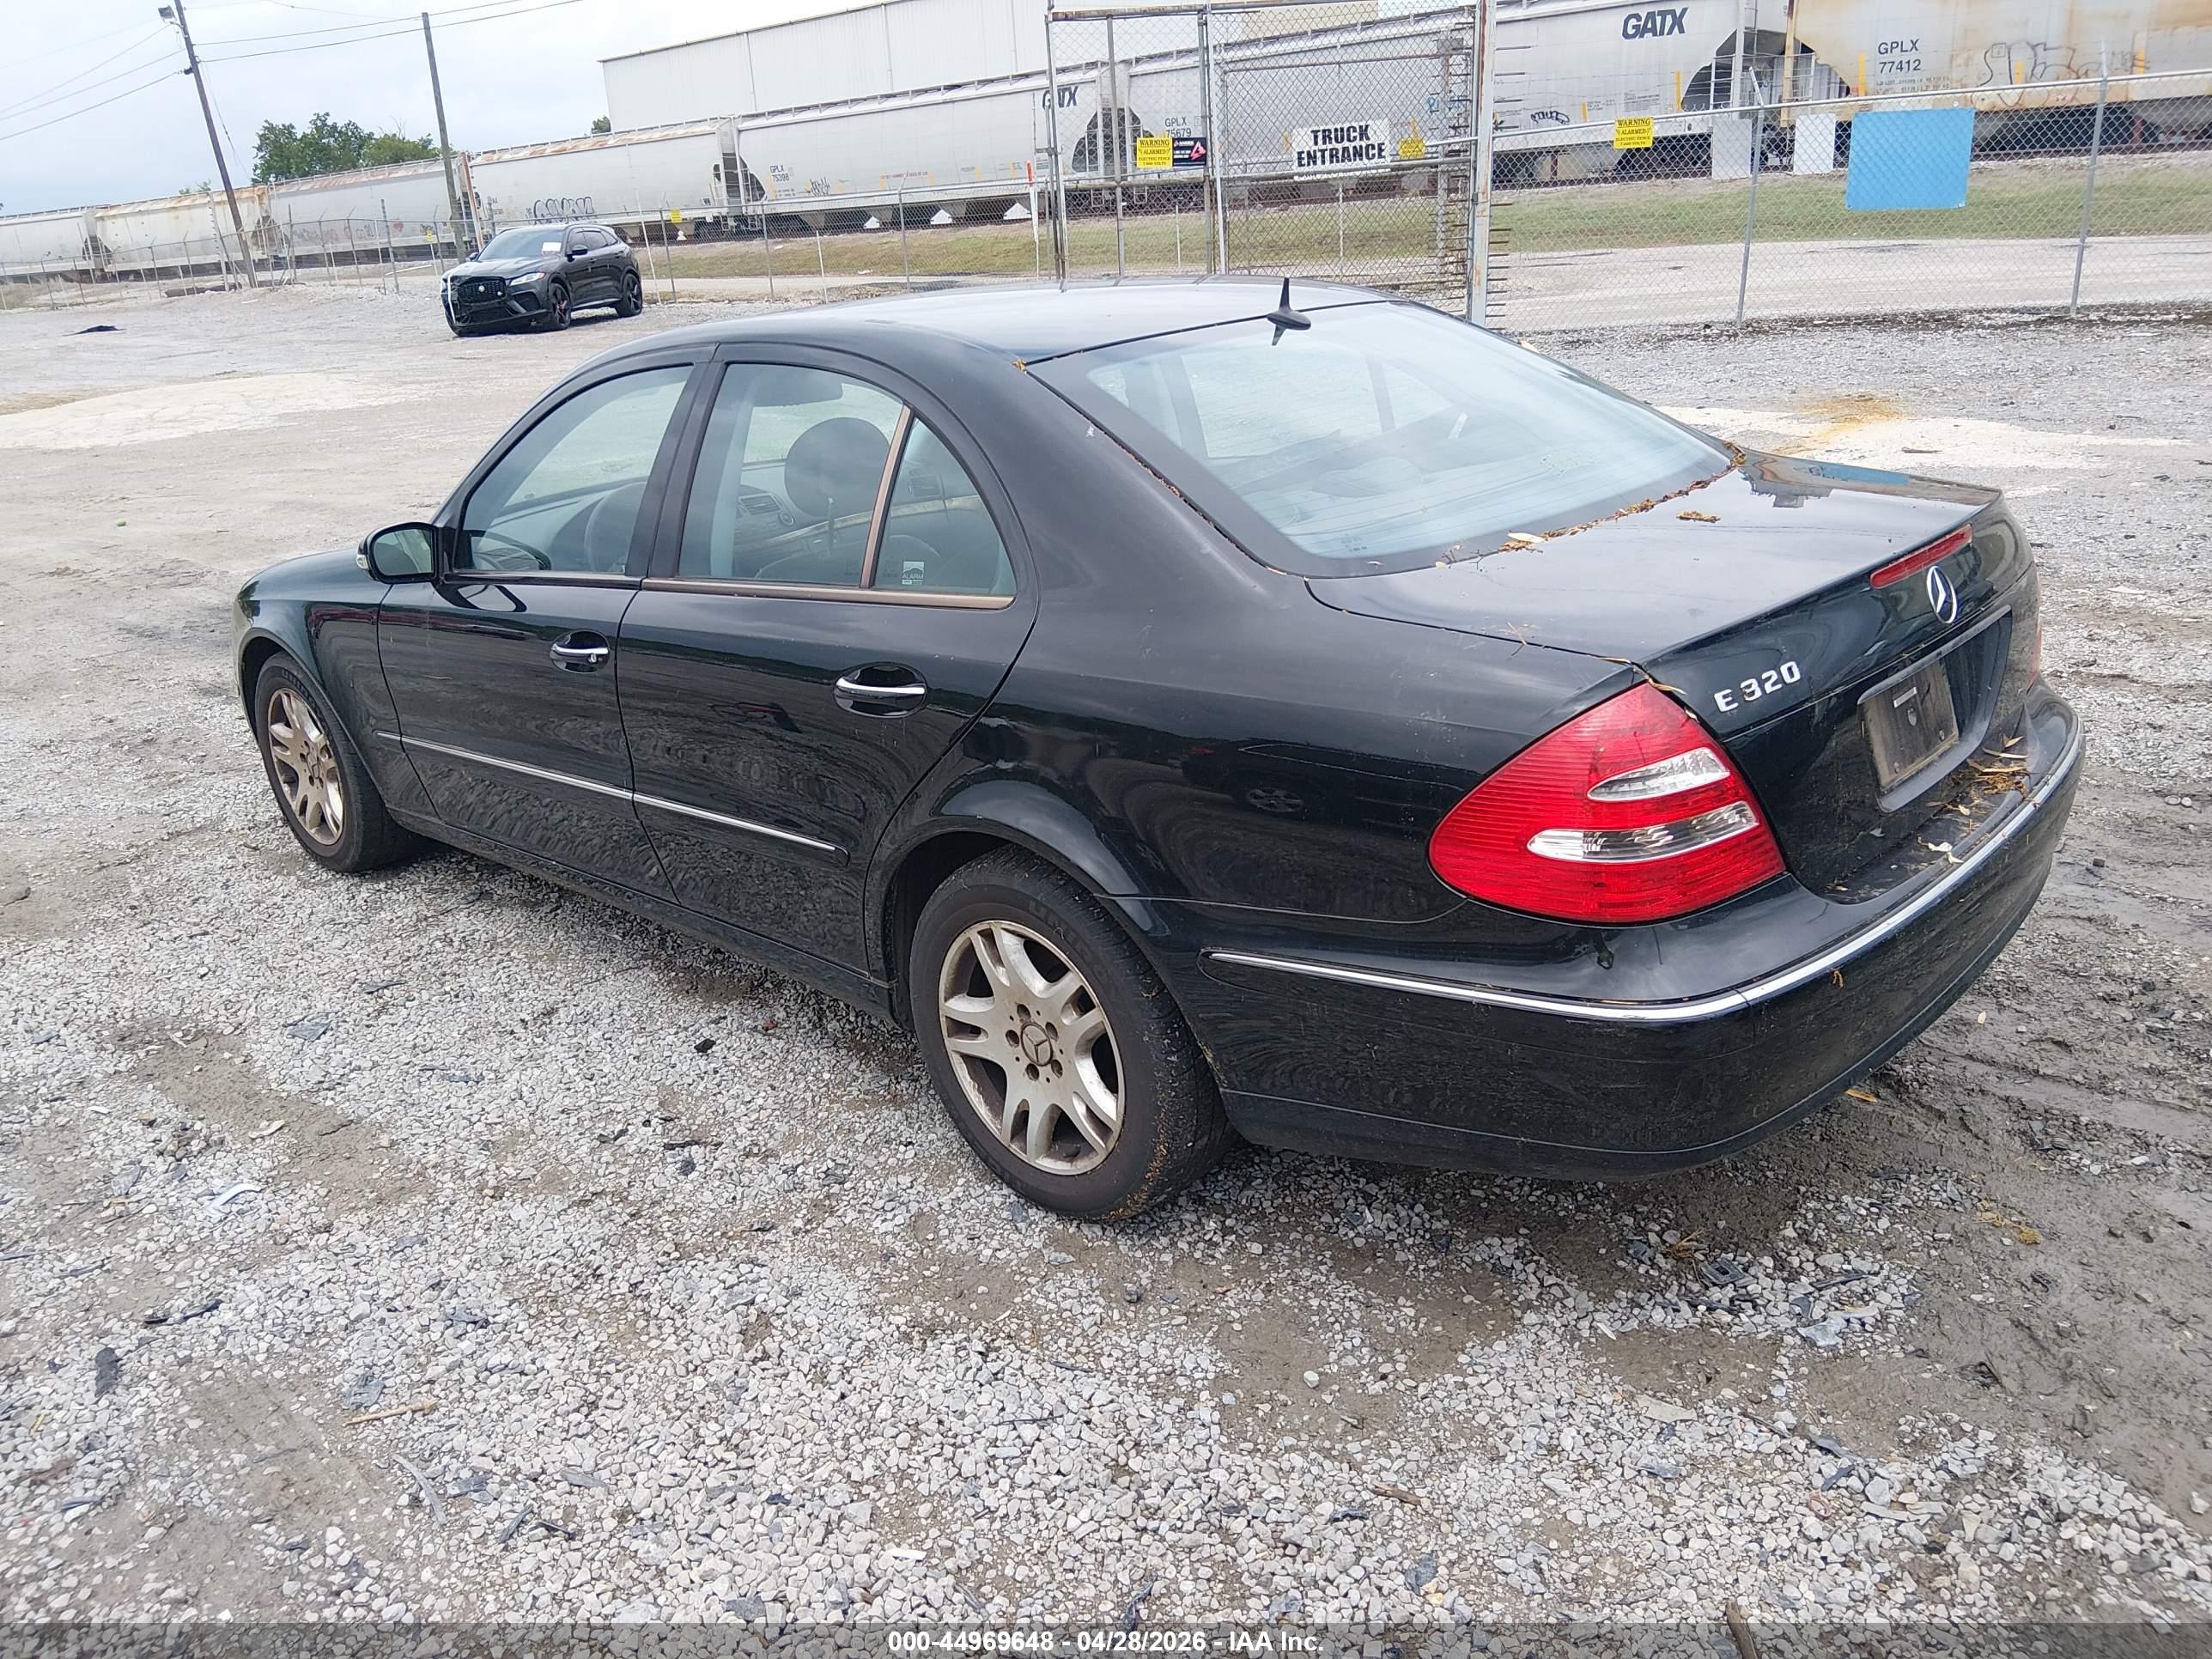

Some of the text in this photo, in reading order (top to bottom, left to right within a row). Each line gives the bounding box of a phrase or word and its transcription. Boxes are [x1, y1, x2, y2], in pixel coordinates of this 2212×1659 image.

[1622, 7, 1689, 40] GATX
[1878, 39, 1920, 55] GPLX
[1879, 58, 1922, 74] 77412
[1165, 117, 1187, 127] GPLX
[1166, 127, 1192, 137] 75679
[1310, 125, 1370, 146] TRUCK
[1297, 143, 1387, 167] ENTRANCE
[1714, 660, 1801, 712] E 320
